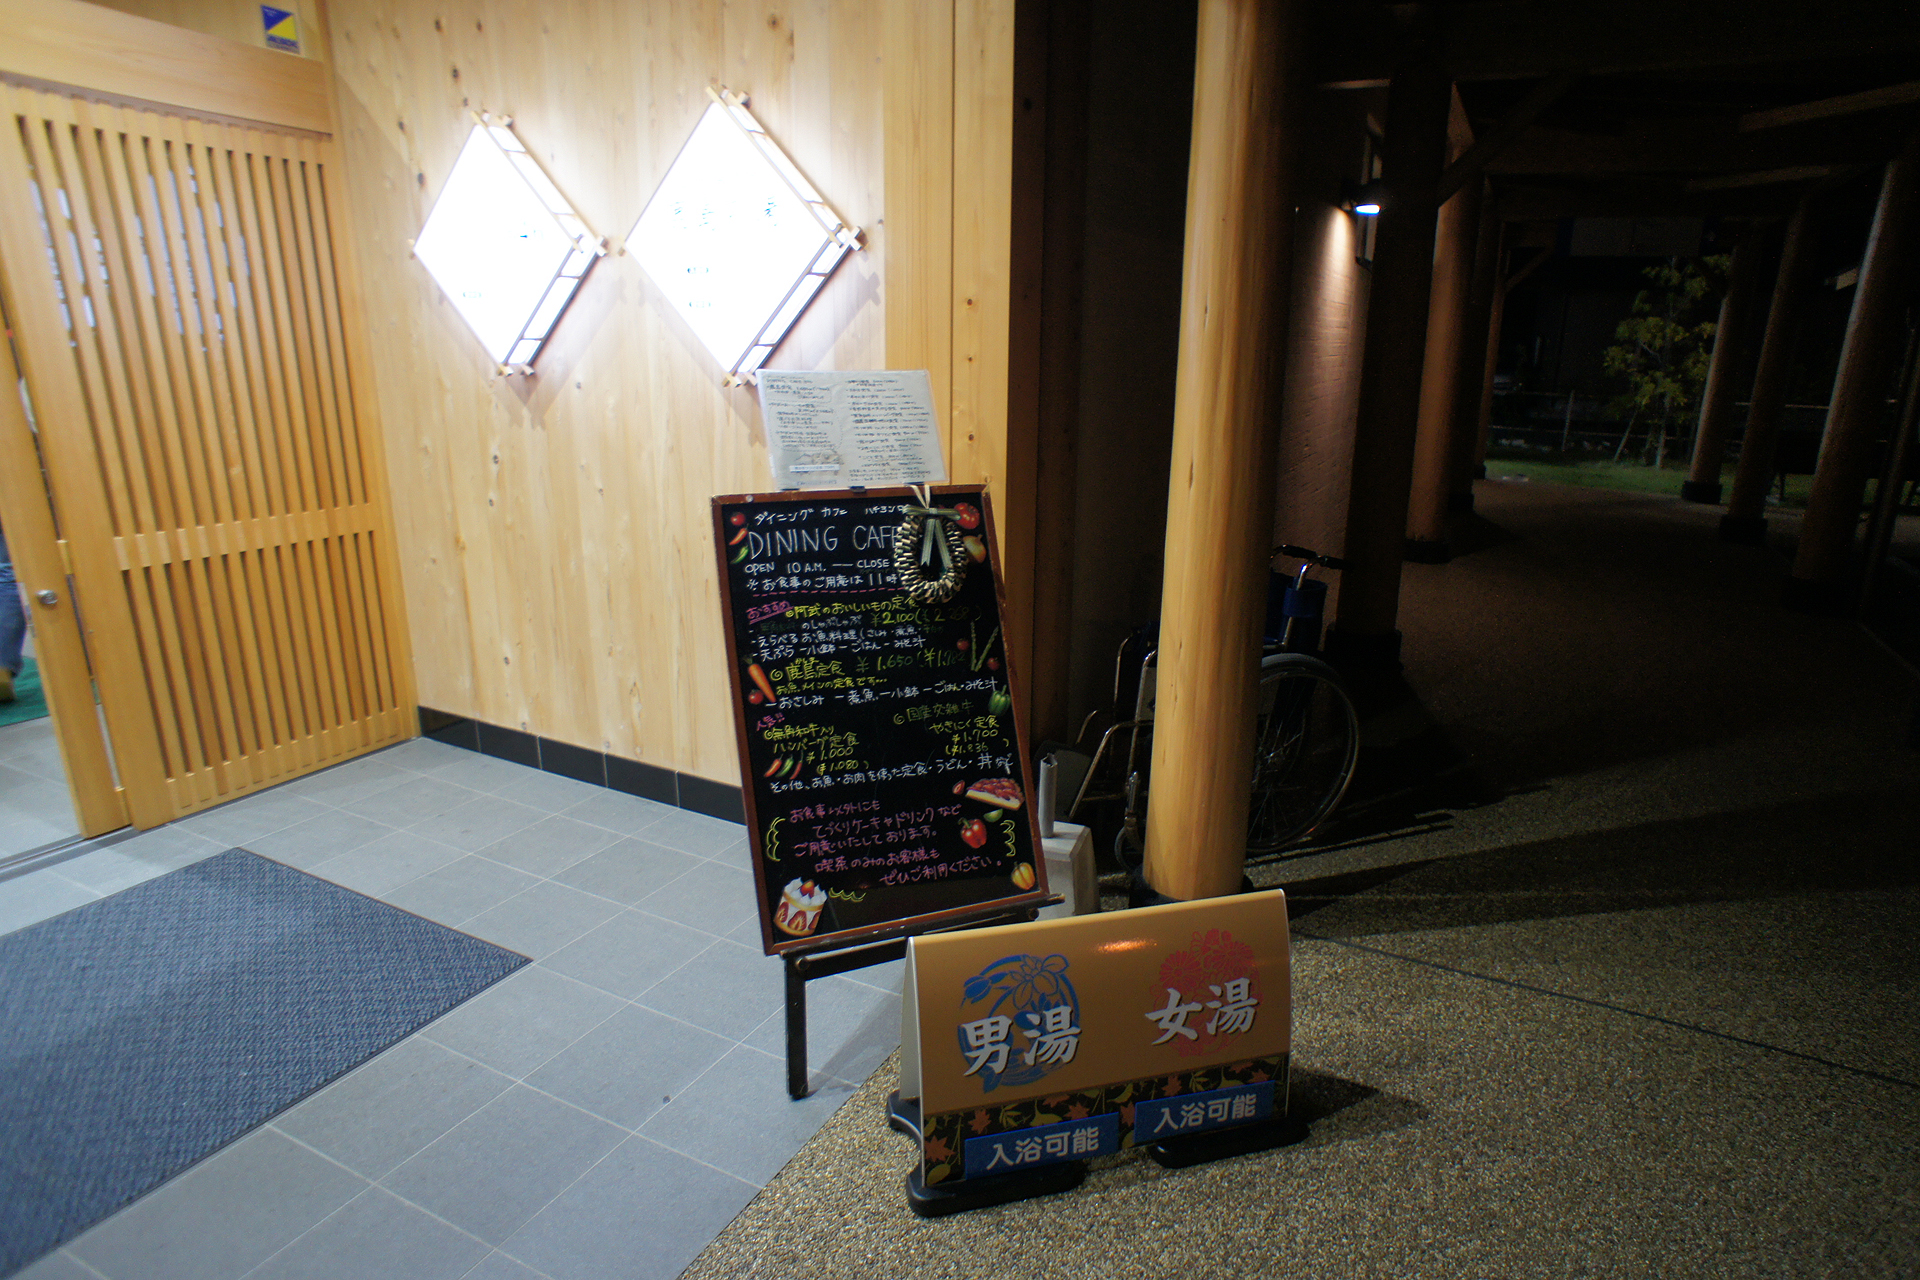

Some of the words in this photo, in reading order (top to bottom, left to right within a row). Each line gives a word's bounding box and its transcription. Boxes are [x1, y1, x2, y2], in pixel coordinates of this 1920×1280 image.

[755, 508, 814, 526] ダイニング
[821, 507, 848, 517] カフェ
[749, 525, 838, 560] DINING
[853, 525, 900, 551] CAFE
[744, 562, 775, 576] OPEN
[787, 562, 801, 574] 10
[804, 562, 827, 573] A.M.
[856, 558, 890, 569] CLOSE
[760, 645, 795, 662] 天ぷら
[962, 1005, 1083, 1077] 男湯
[1144, 977, 1260, 1046] 女湯
[1153, 1093, 1258, 1134] 入浴可能
[986, 1127, 1100, 1171] 入浴可能
